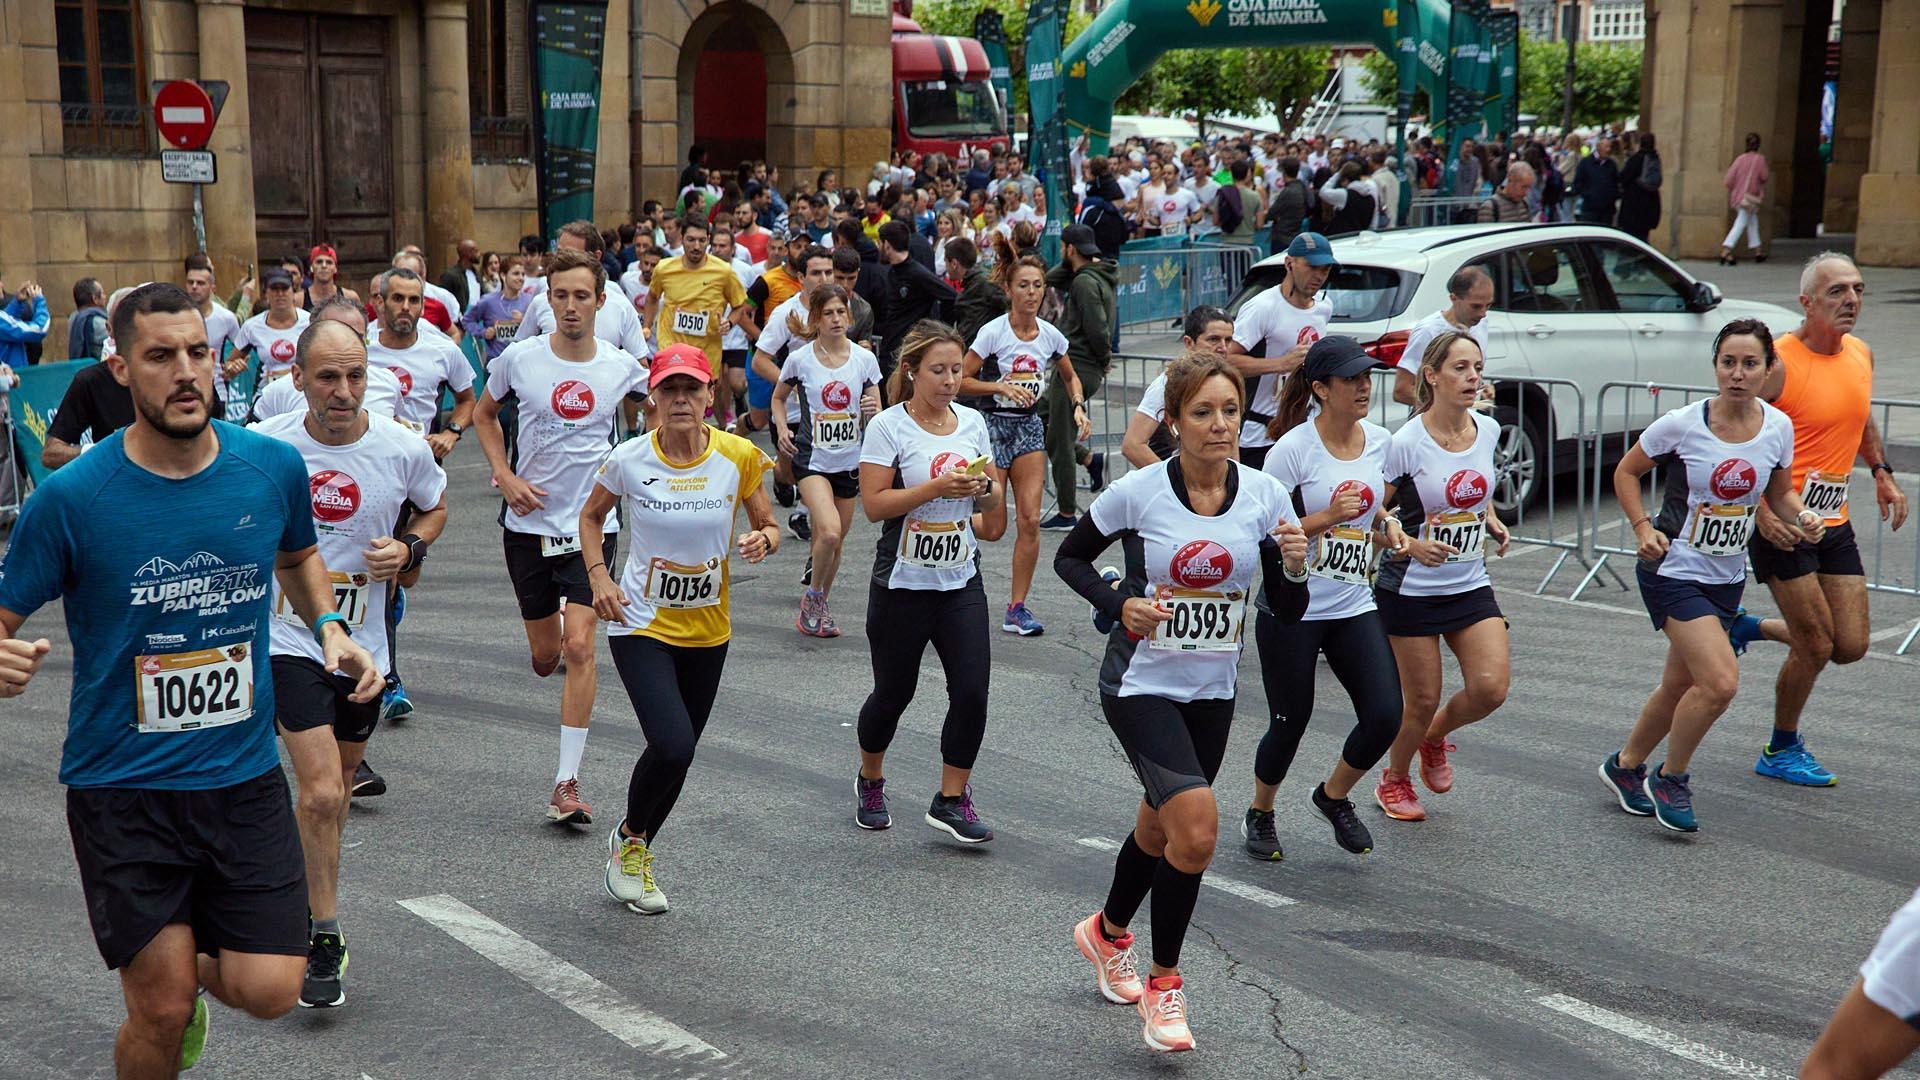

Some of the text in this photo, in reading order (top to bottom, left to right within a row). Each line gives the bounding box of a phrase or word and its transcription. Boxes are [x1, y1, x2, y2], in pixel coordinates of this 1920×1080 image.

[1228, 0, 1320, 12] CAJA RURAL
[1228, 9, 1328, 26] DE NAVARRA
[551, 101, 562, 109] DE
[678, 313, 704, 331] 10510
[559, 398, 590, 408] MEDIA
[819, 420, 855, 443] 10482
[1718, 479, 1751, 487] MEDIA
[312, 493, 353, 507] MEDIA
[1454, 487, 1484, 498] MEDIA
[1433, 523, 1482, 554] 10477
[913, 533, 961, 562] 10619
[1181, 566, 1223, 576] MEDIA
[1194, 558, 1212, 568] LA
[659, 572, 712, 603] 10136
[161, 583, 267, 614] PAMPLONA
[1165, 601, 1232, 640] 10393
[153, 666, 241, 720] 10622
